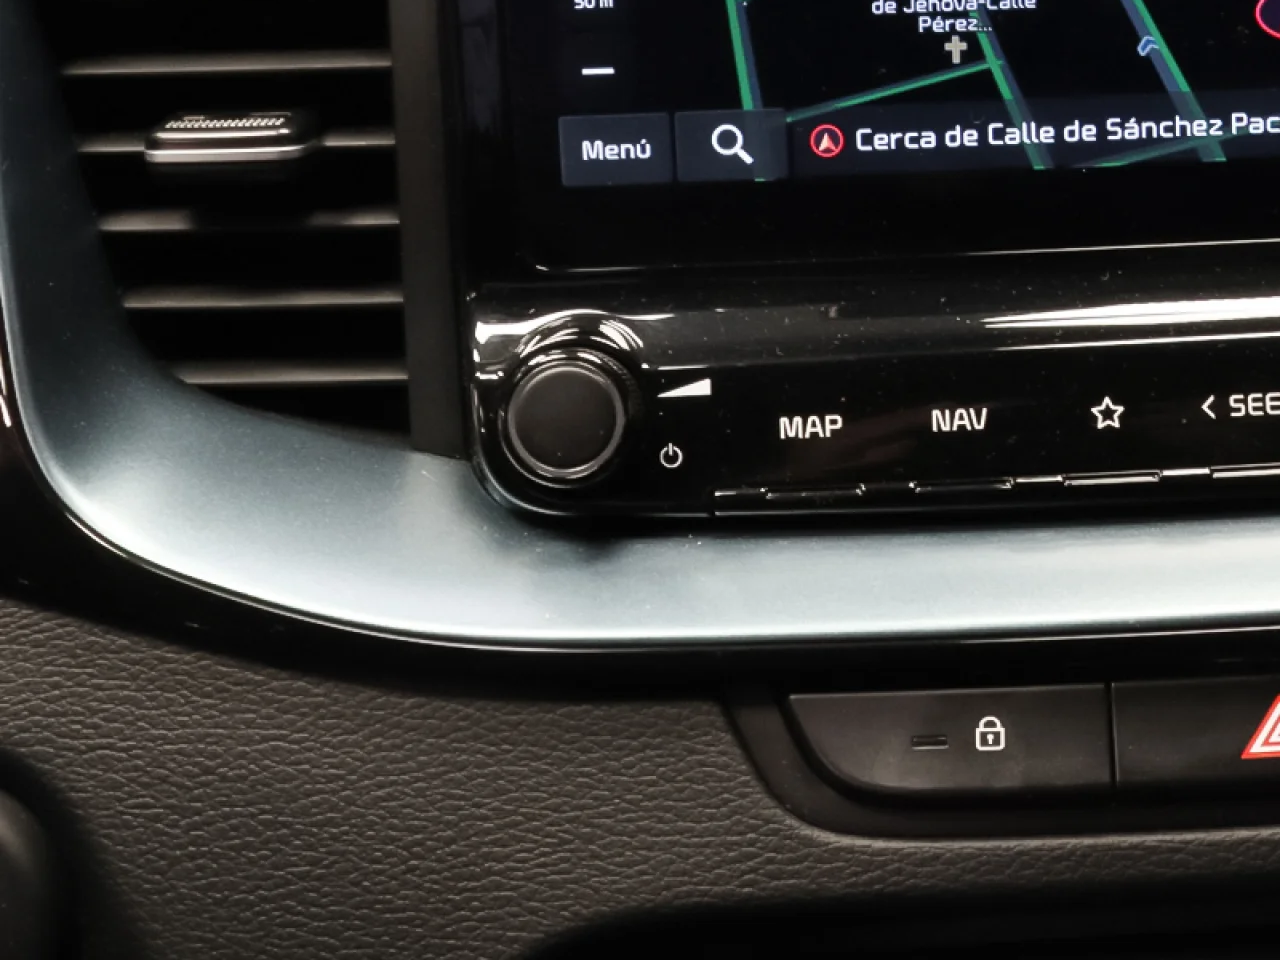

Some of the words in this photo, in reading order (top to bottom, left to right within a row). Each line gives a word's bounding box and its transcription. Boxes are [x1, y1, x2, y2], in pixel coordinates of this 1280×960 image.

[917, 14, 993, 33] Pérez...
[855, 127, 936, 153] Cerca
[942, 122, 980, 149] de
[986, 121, 1057, 147] Calle
[1062, 118, 1098, 144] de
[1105, 116, 1224, 141] Sánchez
[581, 138, 652, 162] Menú
[778, 413, 844, 440] MAP
[930, 406, 990, 433] NAV
